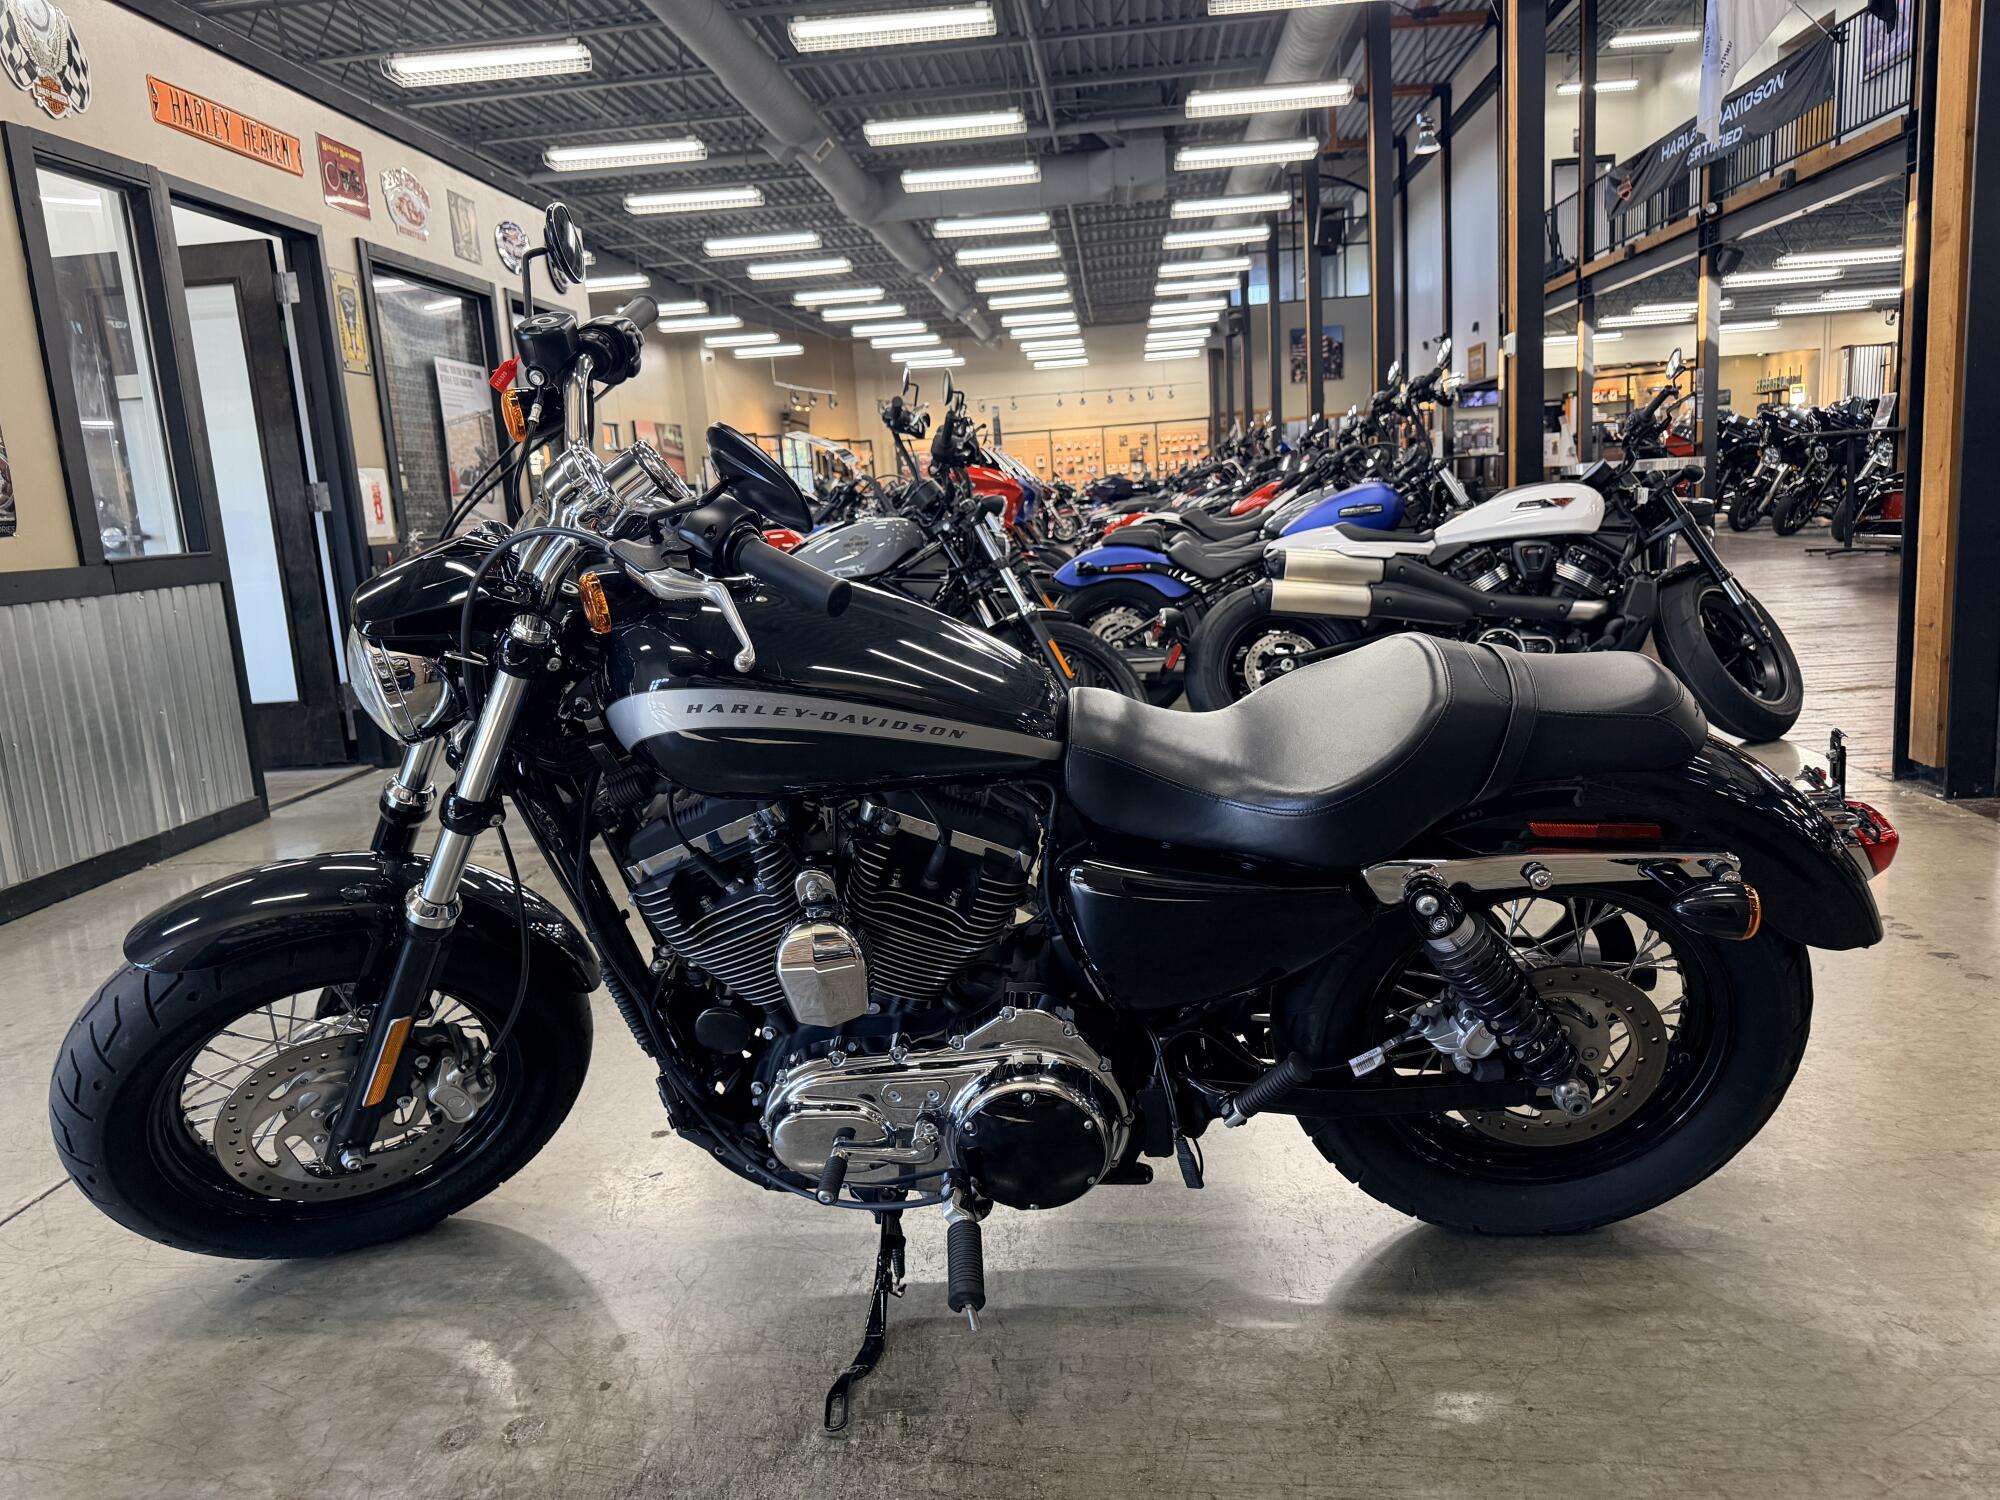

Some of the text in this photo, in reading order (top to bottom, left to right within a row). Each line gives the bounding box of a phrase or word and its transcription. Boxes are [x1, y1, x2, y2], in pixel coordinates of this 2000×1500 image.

[169, 87, 293, 167] HARLEY HEAVEN
[686, 703, 966, 740] HARLEY-DAVIDSON
